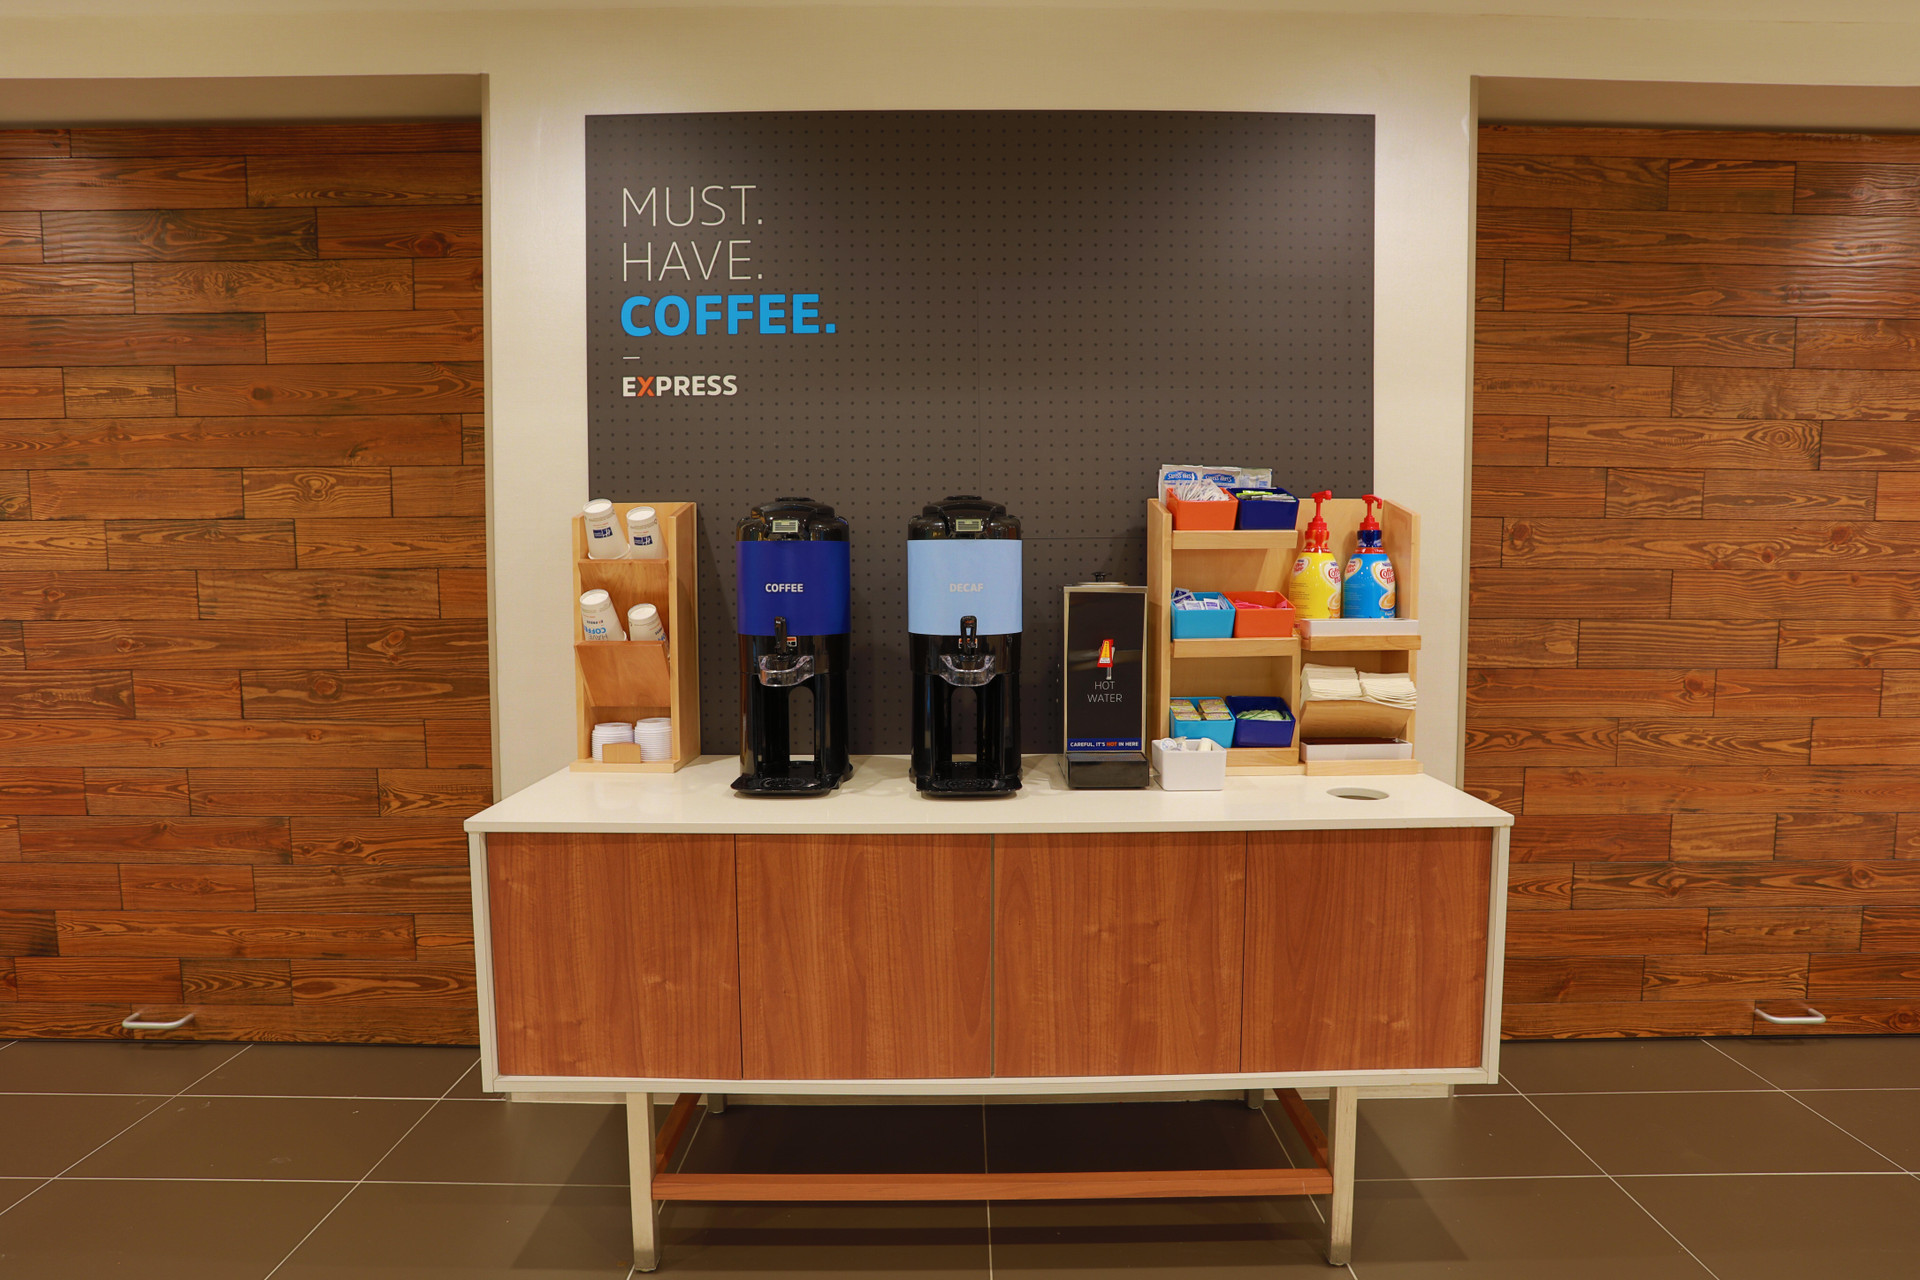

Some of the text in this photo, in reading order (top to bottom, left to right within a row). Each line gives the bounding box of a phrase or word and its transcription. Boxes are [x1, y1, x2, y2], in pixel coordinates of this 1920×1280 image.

[622, 184, 763, 228] MUST.
[623, 240, 763, 282] HAVE.
[620, 293, 836, 337] COFFEE.
[622, 375, 738, 397] EXPRESS
[765, 582, 804, 593] COFFEE
[949, 582, 984, 593] DECAF
[1094, 681, 1115, 690] HOT
[1087, 694, 1123, 703] WATER
